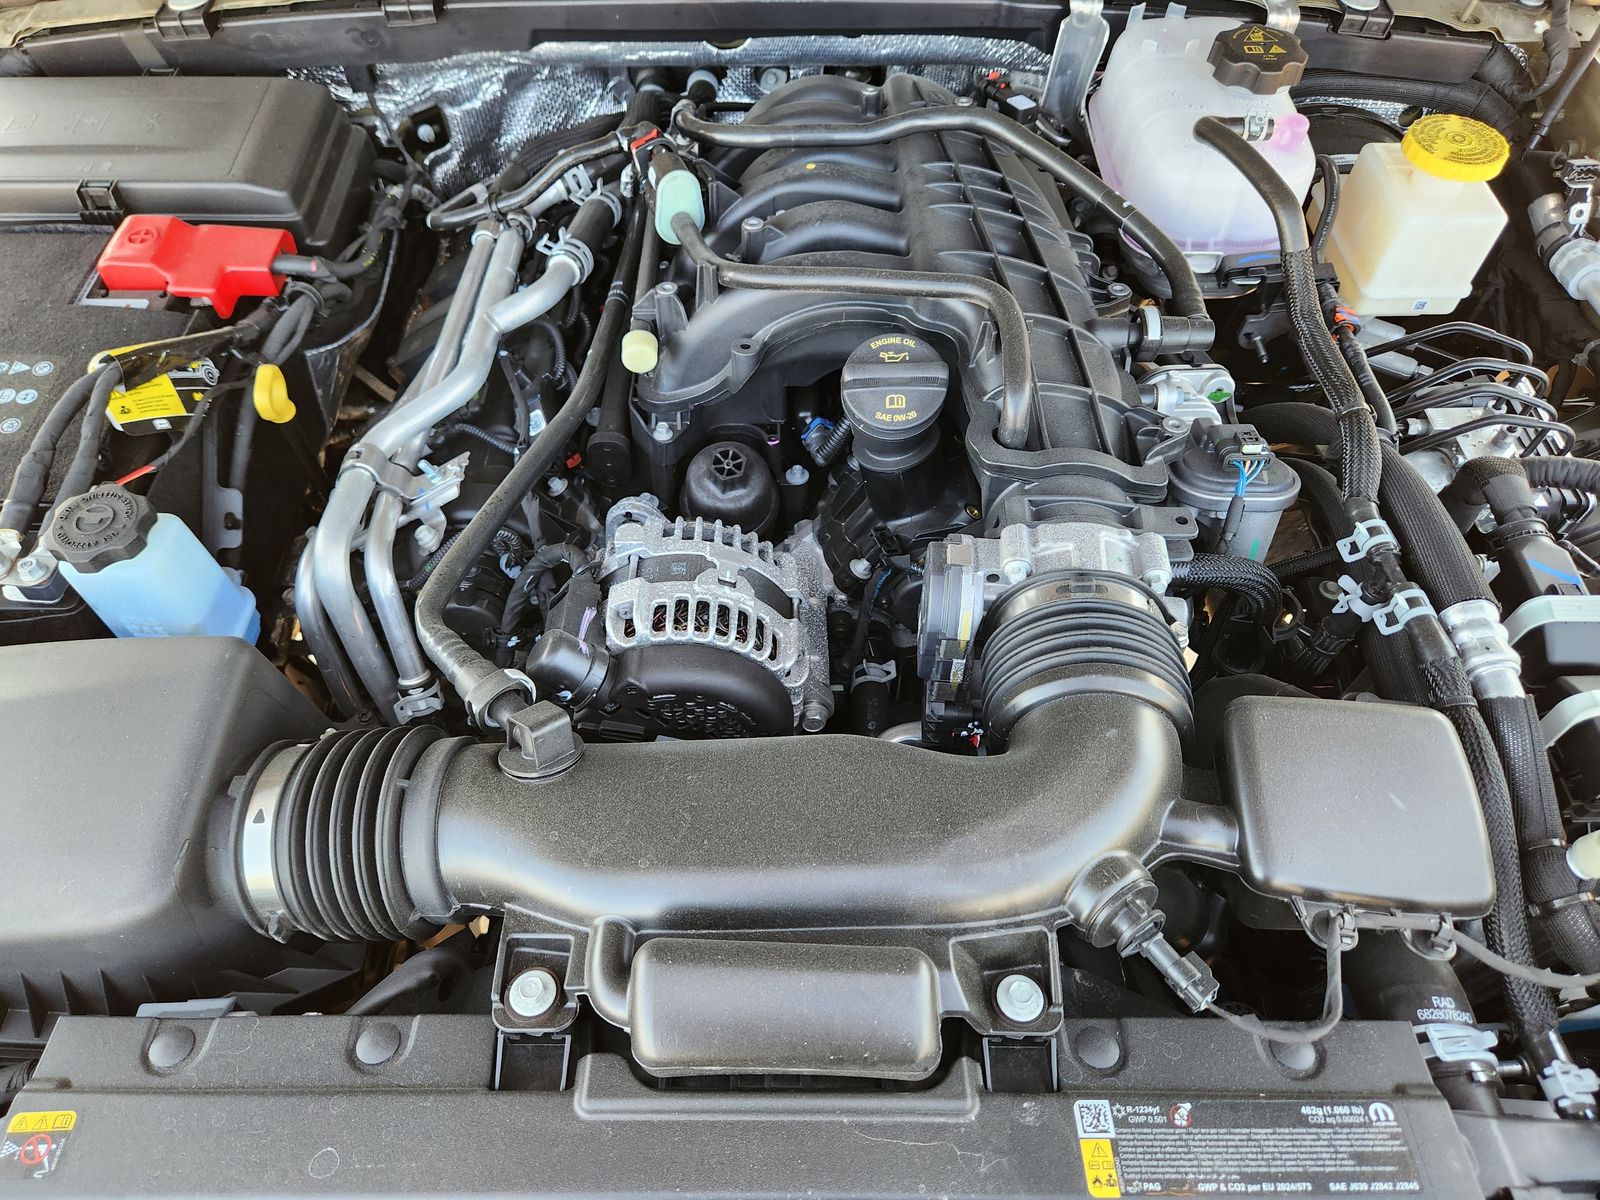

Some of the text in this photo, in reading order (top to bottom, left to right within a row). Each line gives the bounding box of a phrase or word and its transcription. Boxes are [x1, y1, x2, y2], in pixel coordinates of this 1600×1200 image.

[870, 337, 916, 349] ENGINE OIL
[875, 410, 917, 422] SAE 0W-20
[1431, 996, 1455, 1008] RAD
[1126, 1105, 1160, 1115] R-1234yf
[1300, 1105, 1323, 1115] 482g
[1351, 1105, 1364, 1115] lb)
[1128, 1115, 1168, 1123] GWP 0.501
[1308, 1115, 1325, 1123] CO2
[1143, 1182, 1161, 1191] PAG
[1197, 1182, 1218, 1192] GWP
[1220, 1183, 1227, 1191] &
[1228, 1182, 1246, 1191] CO2
[1247, 1184, 1261, 1193] per
[1262, 1182, 1274, 1191] EU
[1328, 1182, 1348, 1191] SAE
